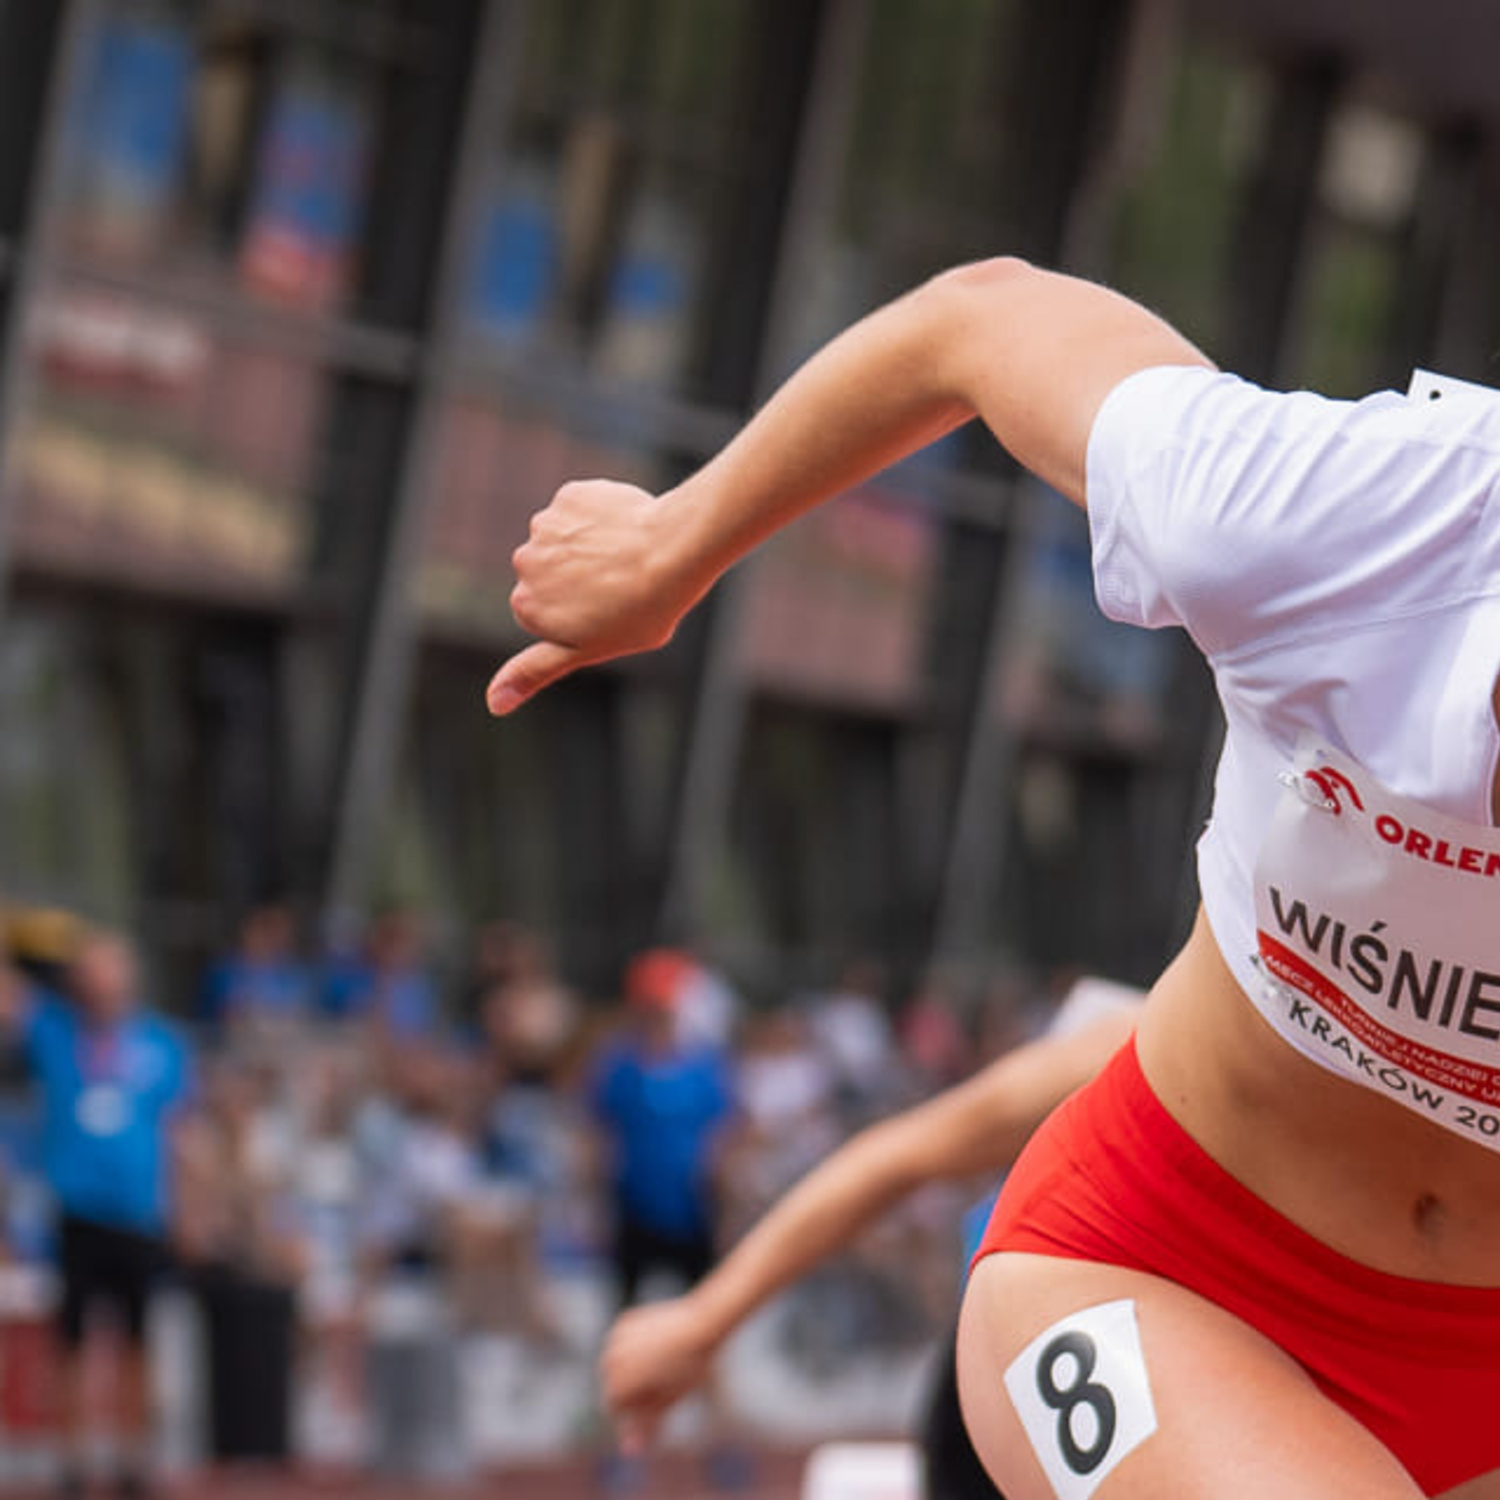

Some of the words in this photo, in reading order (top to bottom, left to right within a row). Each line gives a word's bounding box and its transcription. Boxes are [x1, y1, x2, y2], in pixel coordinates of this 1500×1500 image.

[1288, 999, 1444, 1110] KRAKÓW
[1410, 1047, 1489, 1082] NADZIEI
[1035, 1330, 1117, 1476] 8
